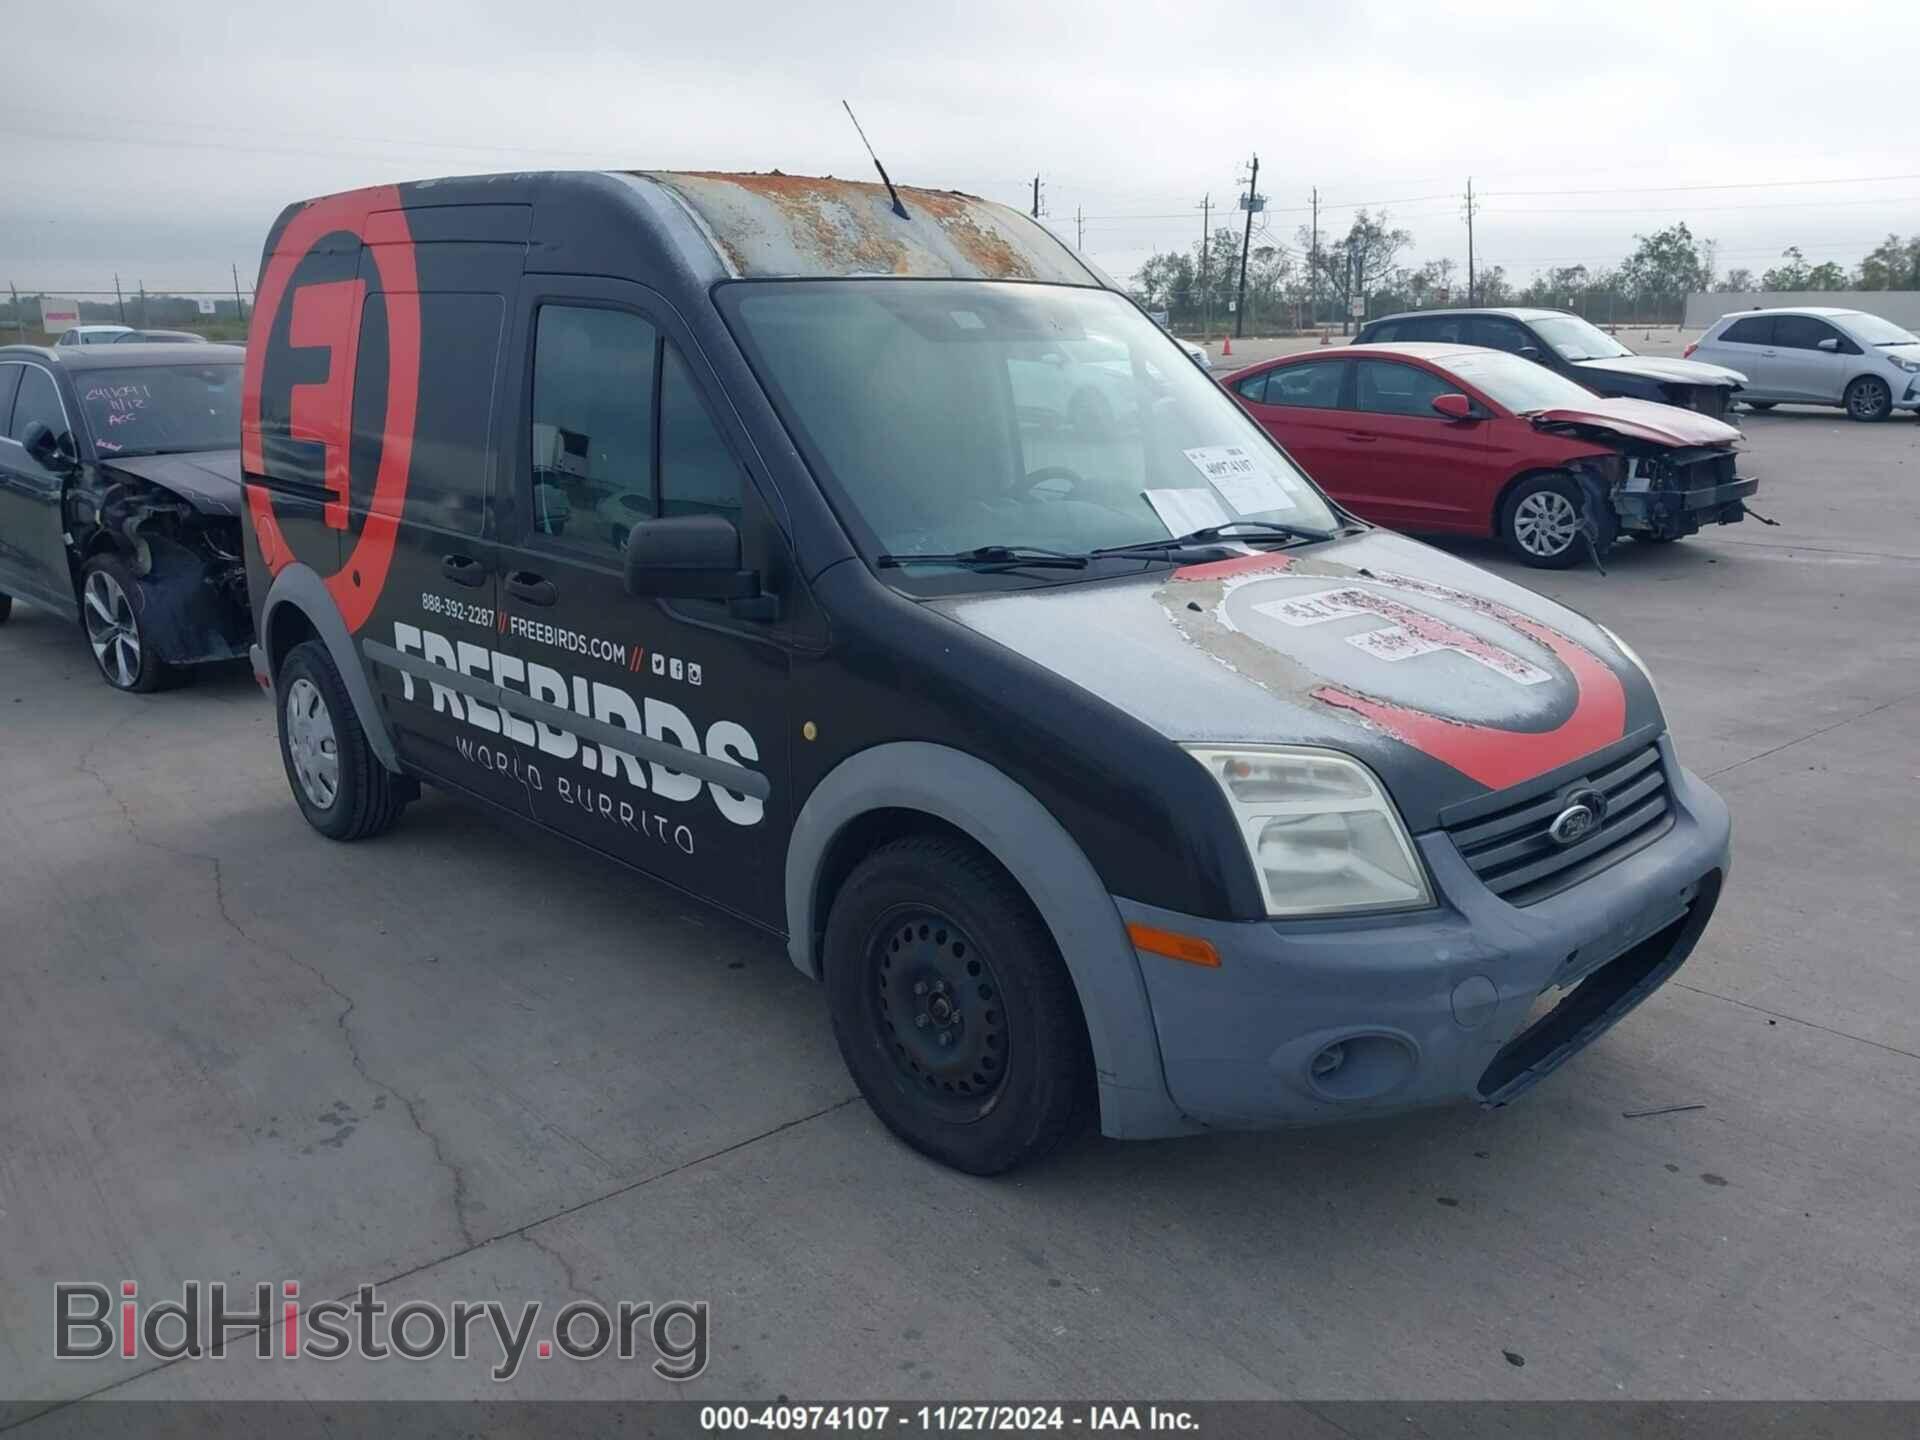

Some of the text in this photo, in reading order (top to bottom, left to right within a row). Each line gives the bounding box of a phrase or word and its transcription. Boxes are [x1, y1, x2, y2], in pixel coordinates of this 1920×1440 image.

[422, 593, 495, 628] 888-392-2287
[510, 616, 626, 665] FREEBIRDS.COM
[456, 735, 695, 854] WORLD BURRITO
